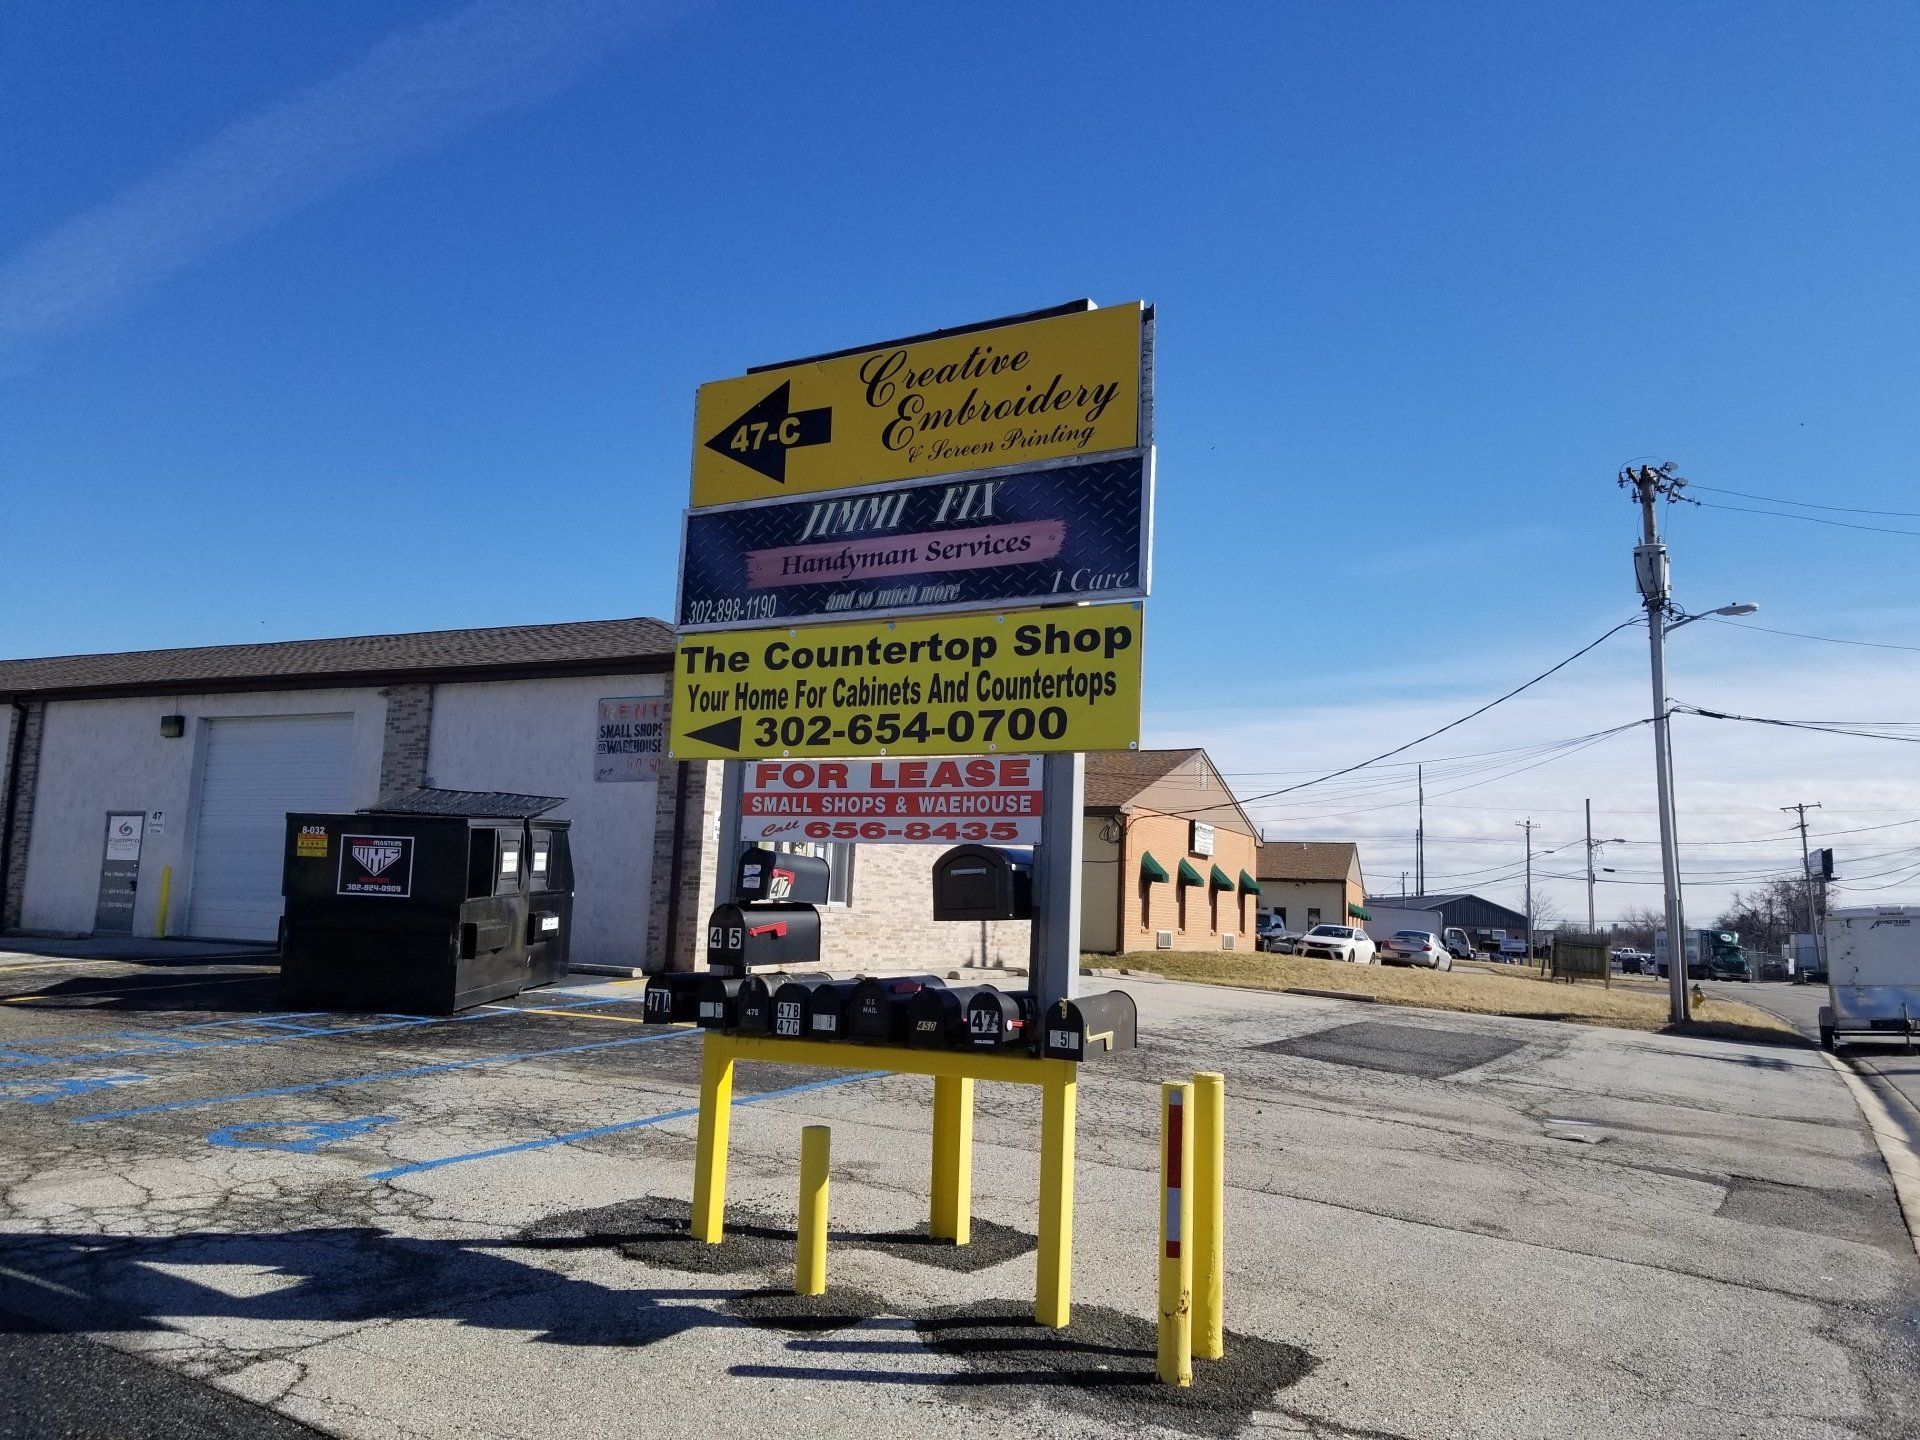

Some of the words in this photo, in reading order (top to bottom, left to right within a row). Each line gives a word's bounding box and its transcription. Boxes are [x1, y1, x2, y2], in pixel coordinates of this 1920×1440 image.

[859, 346, 1030, 408] Creative
[881, 373, 1120, 451] Embroidery
[730, 416, 801, 452] 47-C
[908, 446, 924, 464] &
[928, 438, 996, 462] Screen
[1000, 424, 1096, 449] Printing
[796, 493, 910, 544] JIMMI
[931, 480, 1006, 525] FIX
[780, 546, 917, 580] Handyman
[925, 534, 1032, 562] Services
[1070, 567, 1129, 592] Care
[689, 593, 778, 625] 302-898-1190
[825, 591, 855, 612] and
[856, 593, 872, 609] so
[874, 584, 917, 607] much
[917, 583, 961, 604] more
[681, 646, 750, 674] The
[764, 633, 998, 671] Countertop
[1013, 624, 1132, 659] Shop
[688, 683, 730, 712] Your
[735, 681, 789, 711] Home
[795, 679, 828, 709] For
[832, 674, 921, 708] Cabinets
[927, 671, 970, 704] And
[976, 665, 1117, 706] Countertops
[600, 723, 632, 739] SMALL
[754, 706, 1068, 747] 302-654-0700
[755, 763, 849, 789] FOR
[870, 759, 1031, 789] LEASE
[152, 811, 163, 820] 47
[751, 796, 813, 814] SMALL
[821, 795, 886, 814] SHOPS
[895, 796, 908, 813] &
[918, 794, 1032, 814] WAEHOUSE
[302, 826, 325, 835] 8-032
[760, 819, 800, 838] Call
[804, 821, 1019, 841] 656-8435
[778, 1002, 800, 1018] 47B
[862, 1006, 878, 1014] MAIL
[777, 1020, 799, 1035] 47C
